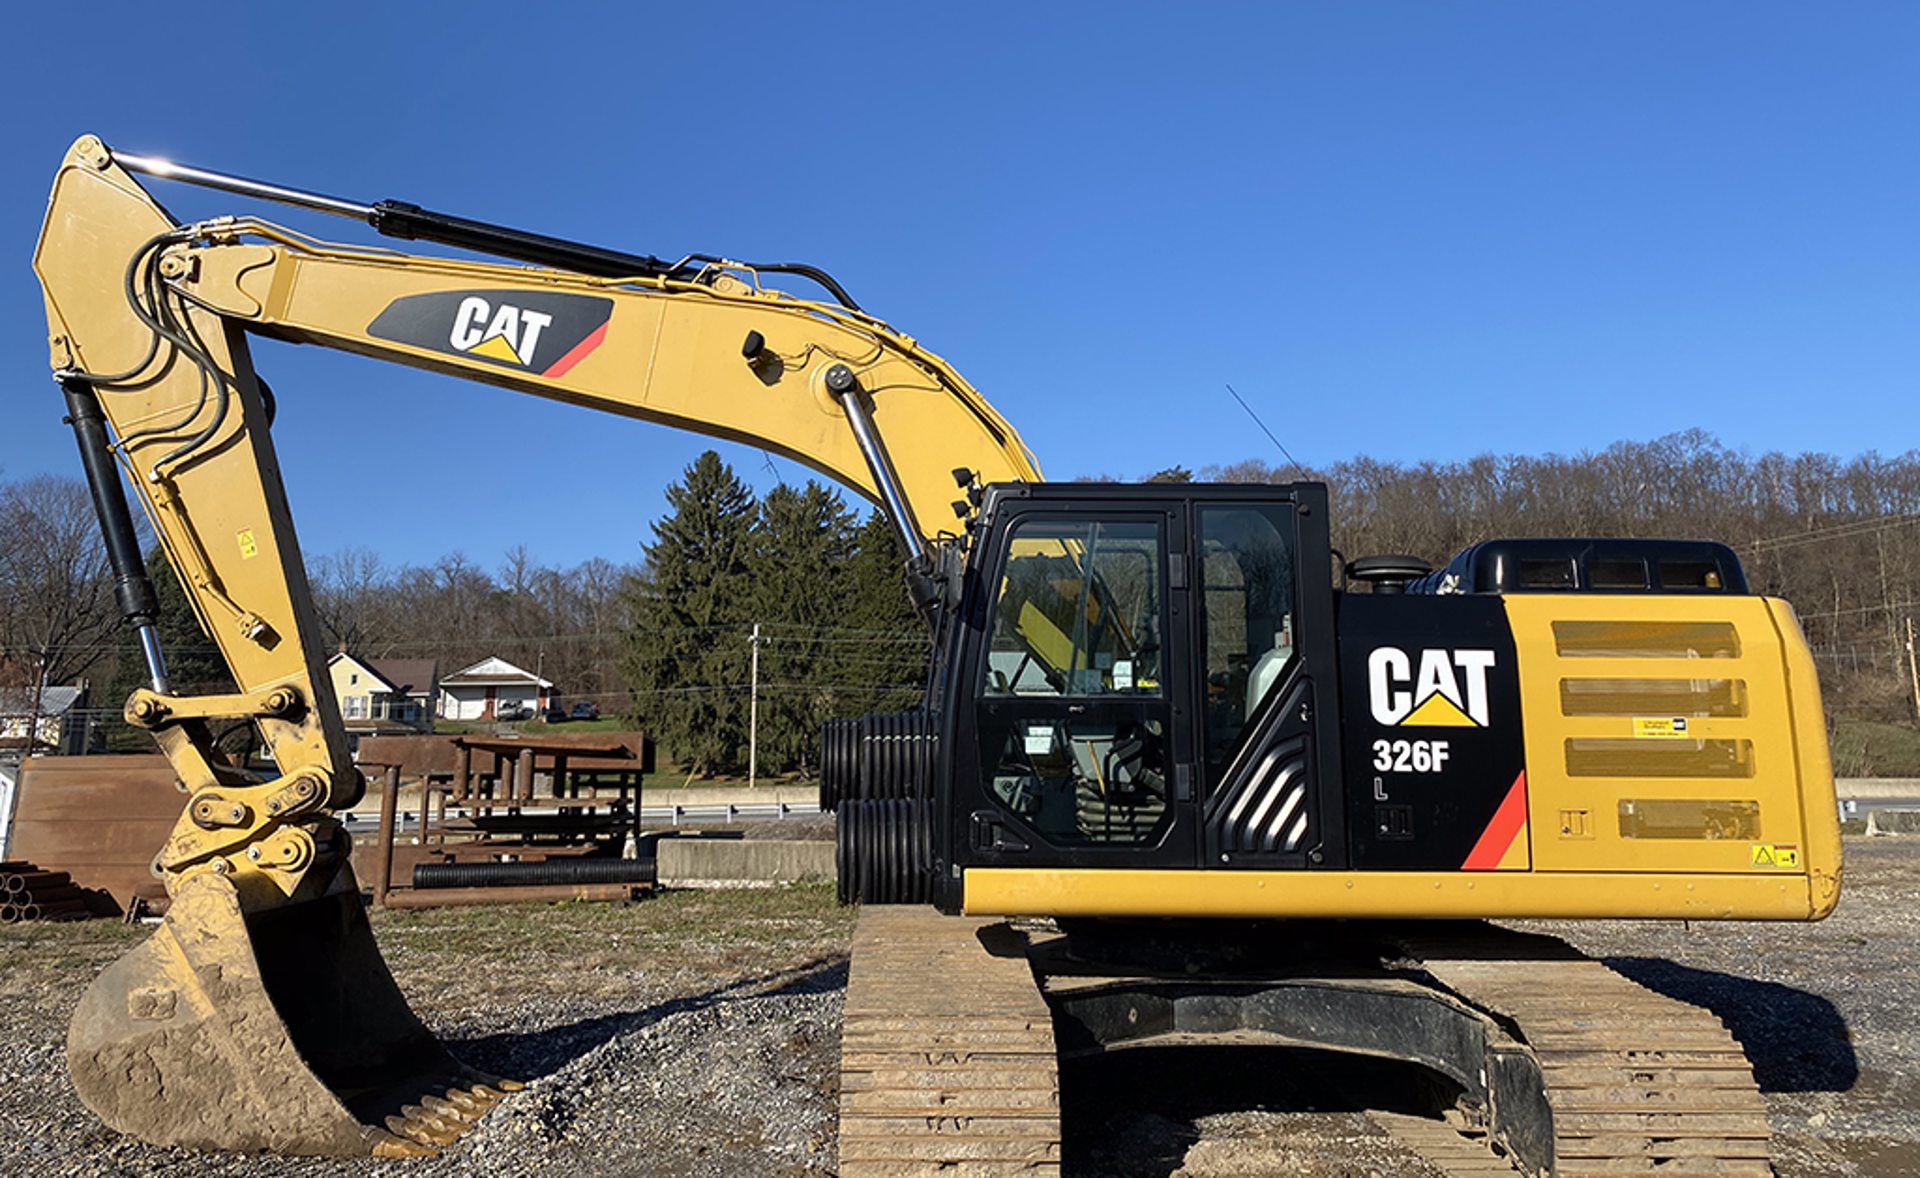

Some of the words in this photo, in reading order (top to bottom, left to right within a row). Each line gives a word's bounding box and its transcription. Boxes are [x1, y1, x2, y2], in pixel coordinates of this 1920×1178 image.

[450, 296, 553, 366] CAT
[1368, 647, 1495, 727] CAT
[1372, 739, 1449, 772] 326F
[1373, 776, 1389, 801] L
